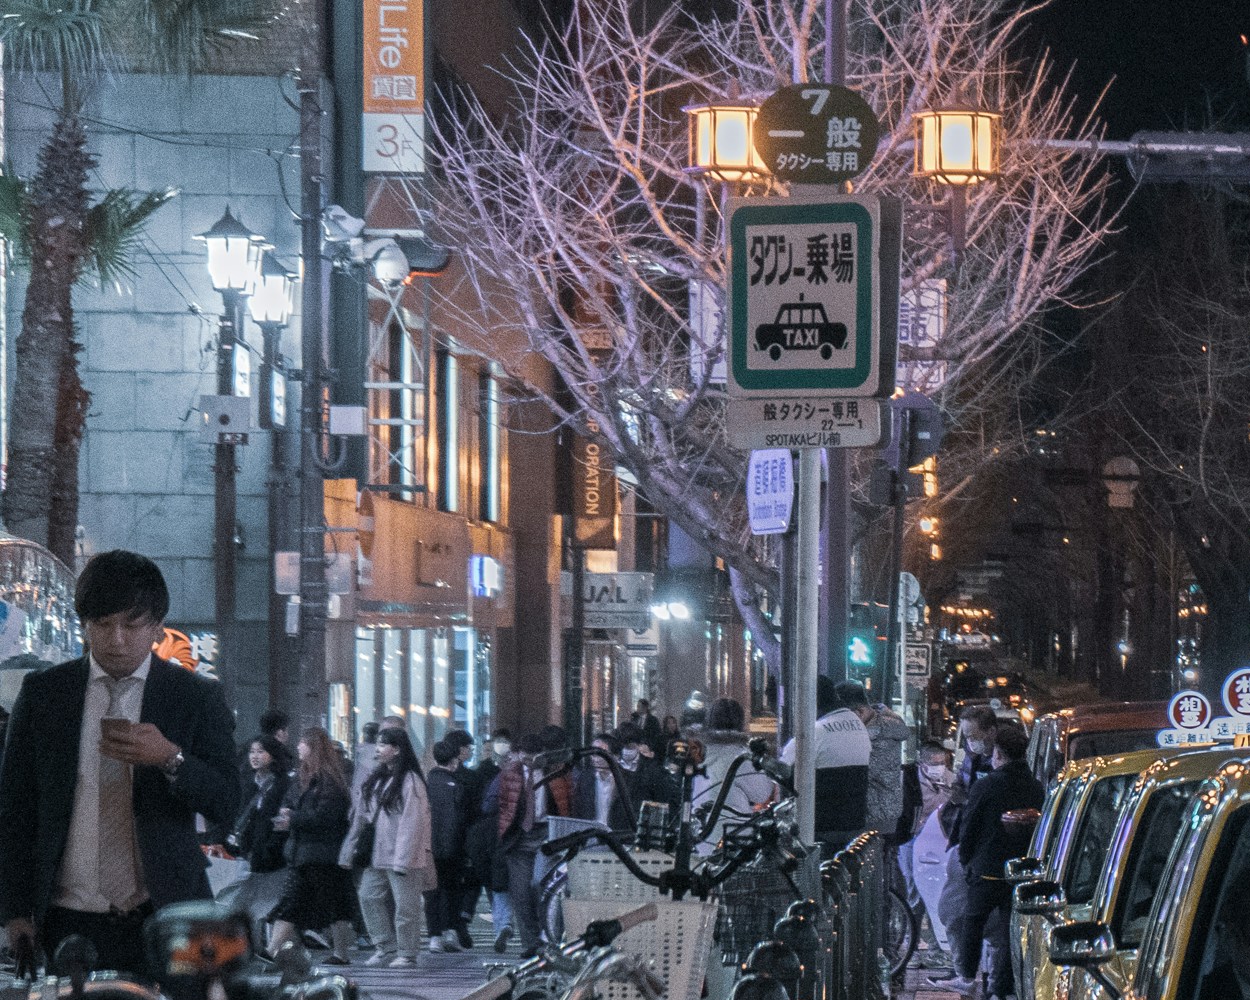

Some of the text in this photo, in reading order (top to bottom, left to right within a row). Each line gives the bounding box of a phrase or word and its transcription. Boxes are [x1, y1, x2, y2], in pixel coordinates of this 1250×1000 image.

[378, 0, 409, 69] Life
[801, 88, 831, 116] 7
[375, 123, 413, 158] 3F
[768, 116, 863, 149] 一般
[776, 151, 859, 172] タクシー専用
[750, 232, 854, 286] タクシー乗場
[782, 328, 820, 347] TAXI
[765, 432, 841, 447] SPOTAKAビル前
